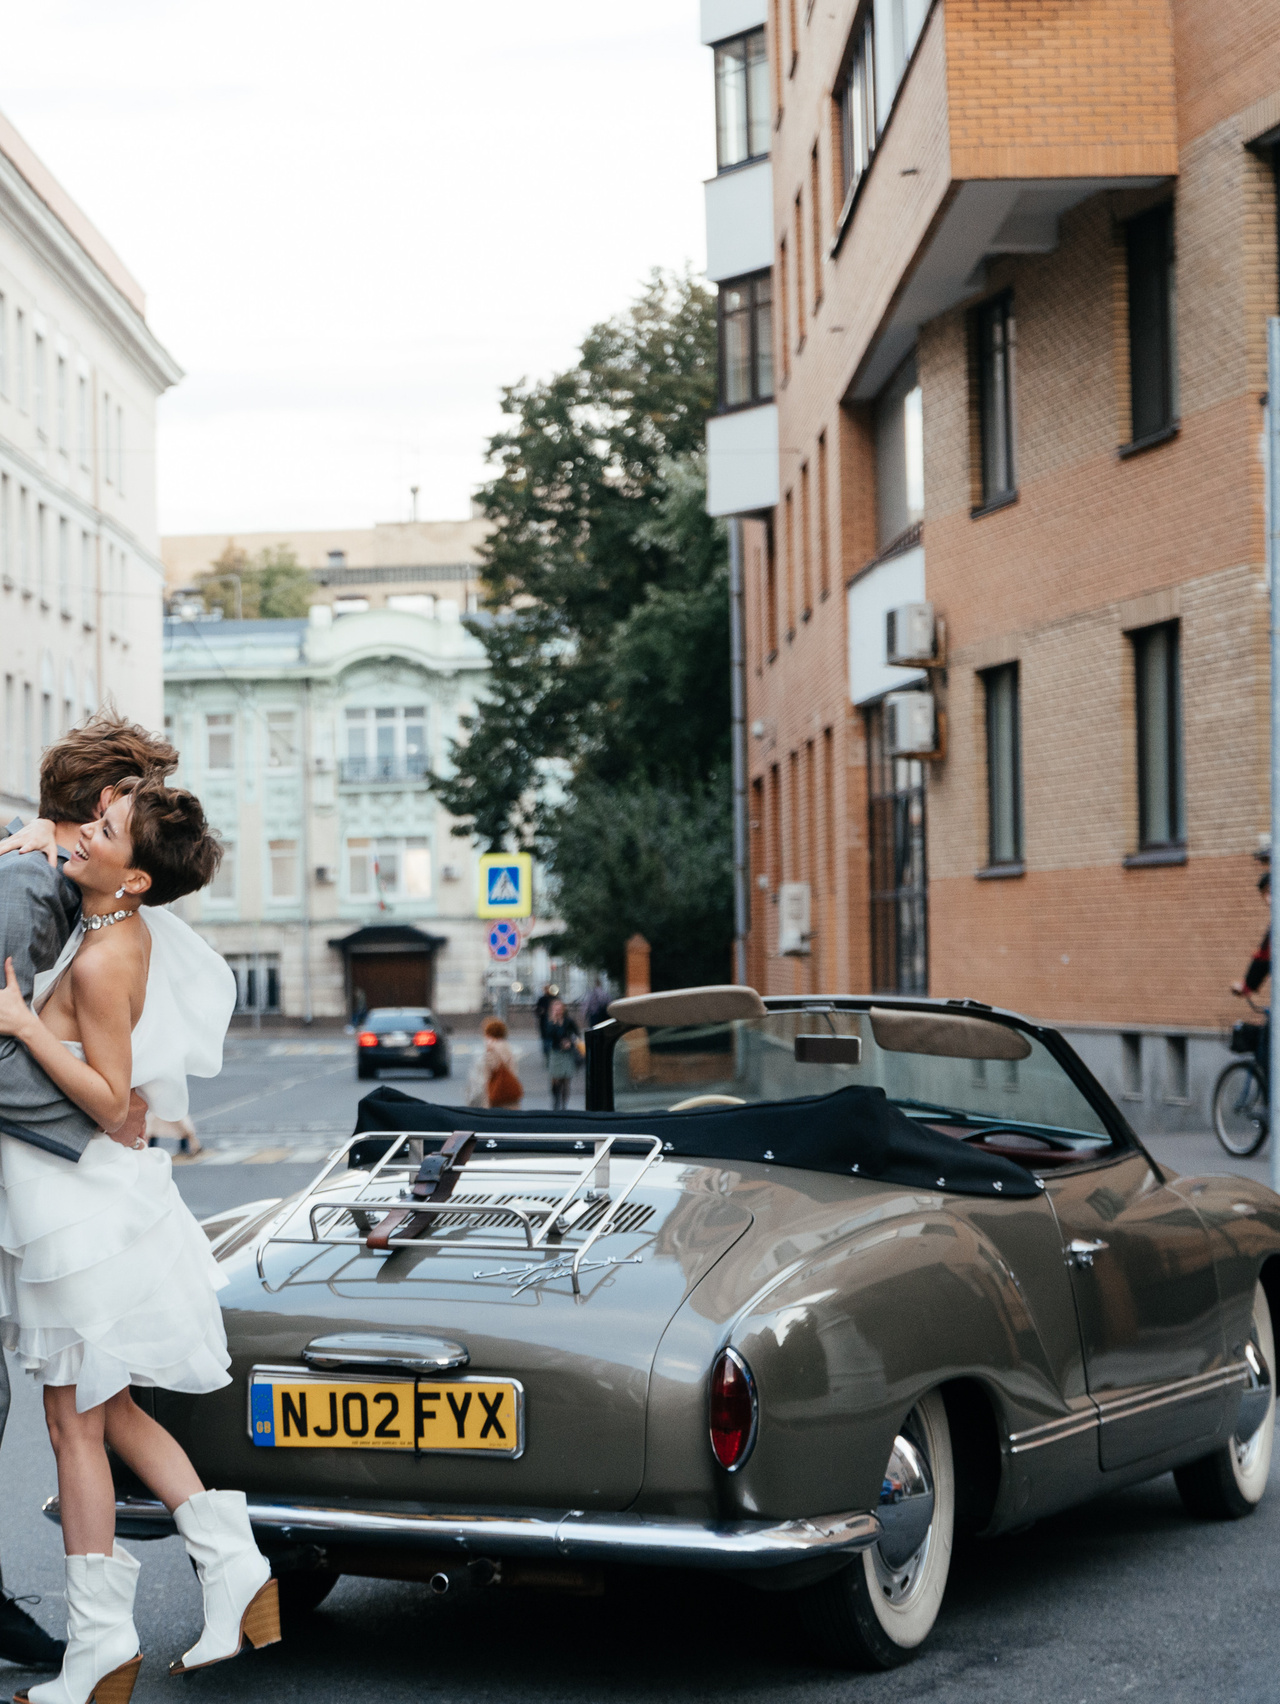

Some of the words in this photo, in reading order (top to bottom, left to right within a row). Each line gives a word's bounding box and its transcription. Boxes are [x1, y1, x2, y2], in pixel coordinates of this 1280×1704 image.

[256, 1421, 271, 1433] GB
[281, 1392, 401, 1438] NJ02
[417, 1392, 507, 1439] FYX
